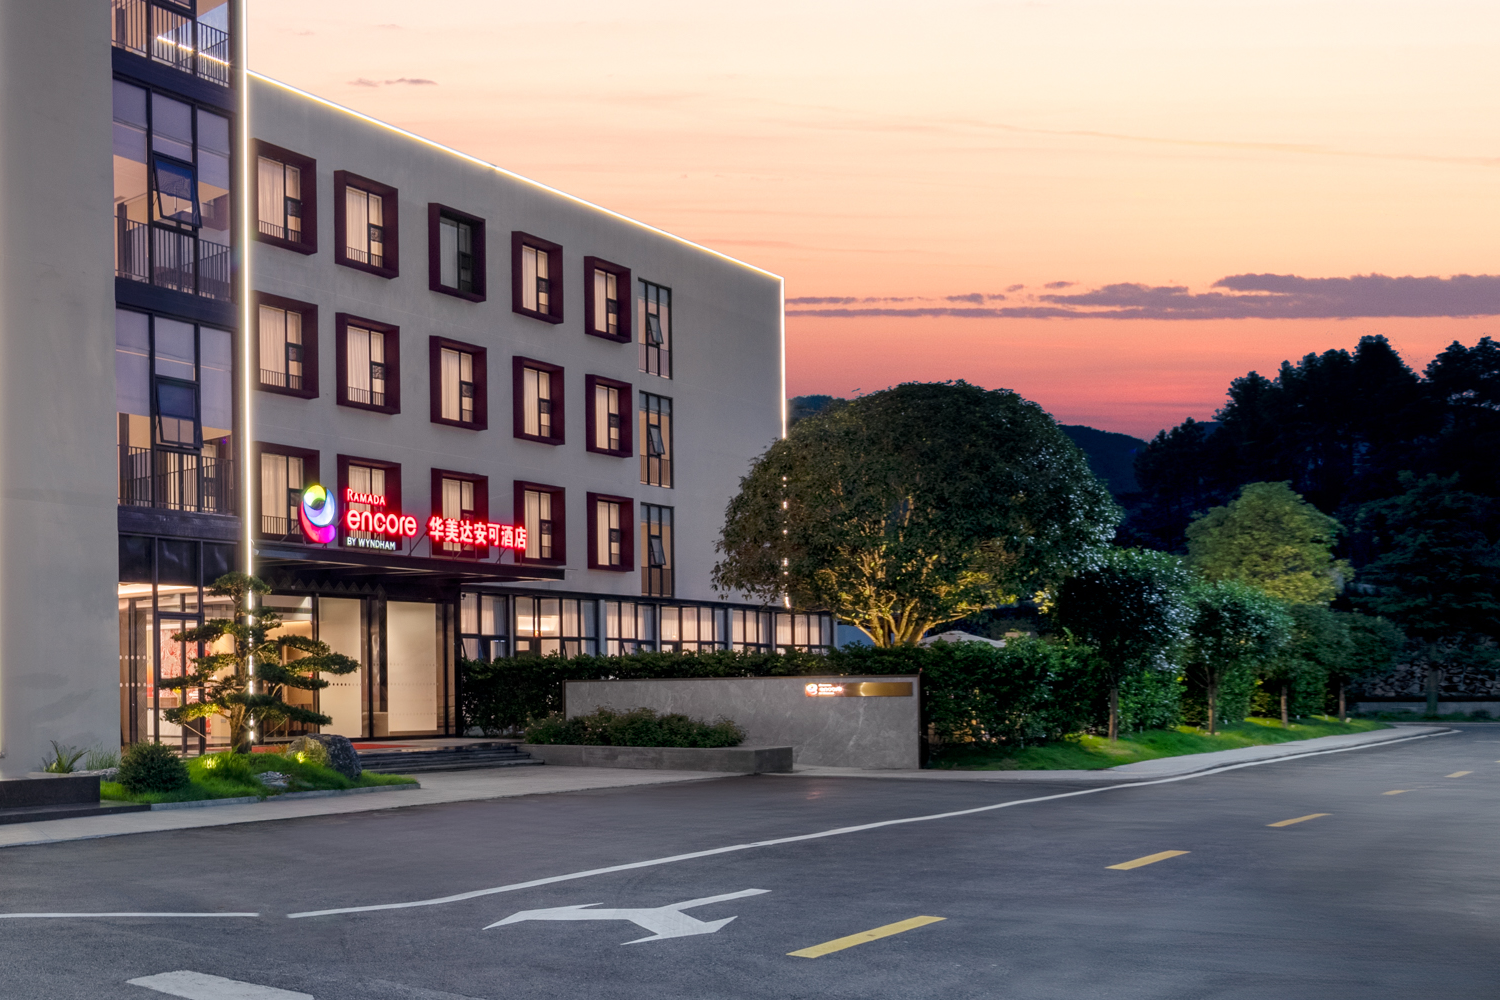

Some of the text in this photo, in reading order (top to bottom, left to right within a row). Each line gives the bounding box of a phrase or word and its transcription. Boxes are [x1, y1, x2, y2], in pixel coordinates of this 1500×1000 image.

[346, 488, 386, 506] RAMADA
[346, 509, 418, 536] encore
[429, 516, 527, 549] 华美达安可酒店
[346, 537, 396, 551] BY WYNDHAM
